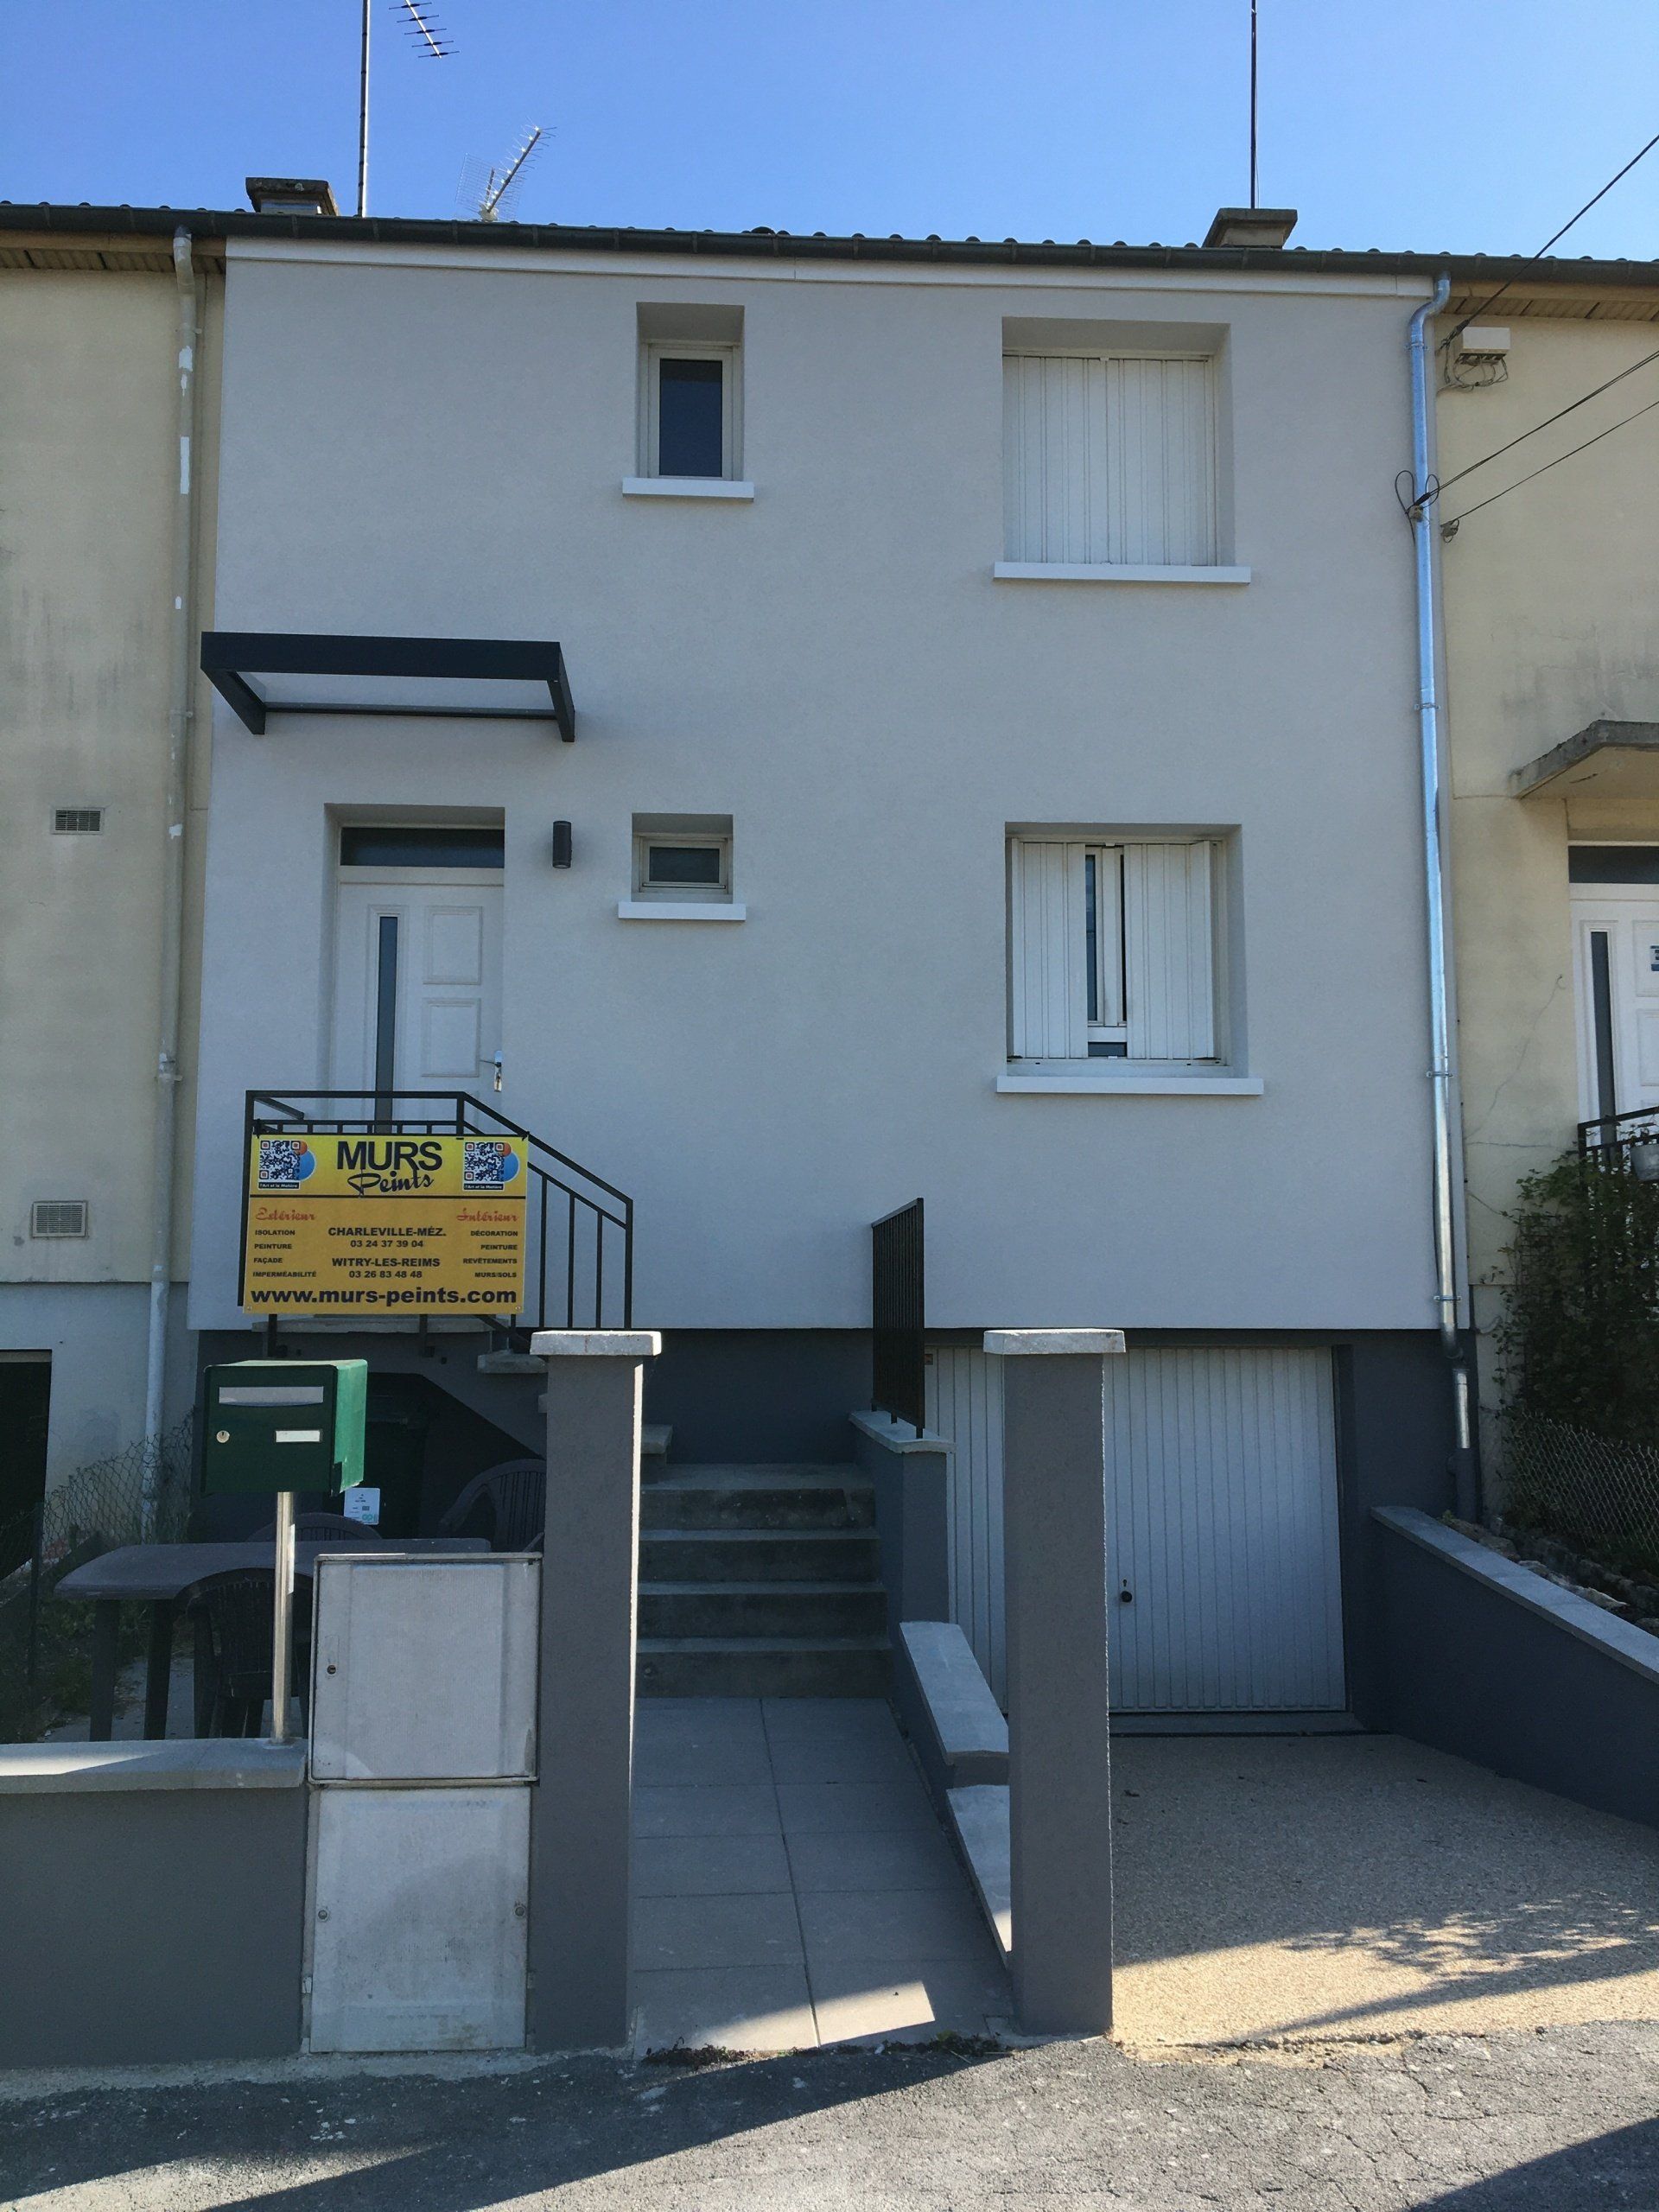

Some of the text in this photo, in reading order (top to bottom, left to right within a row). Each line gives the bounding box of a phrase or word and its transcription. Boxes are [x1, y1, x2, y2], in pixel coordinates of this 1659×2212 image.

[337, 1141, 442, 1170] MURS
[347, 1170, 435, 1196] Peints
[328, 1226, 447, 1236] CHARLEVILLE-MÉZ.
[332, 1257, 441, 1267] WITRY-LES-REIMS
[251, 1287, 517, 1306] www.murs-peints.com
